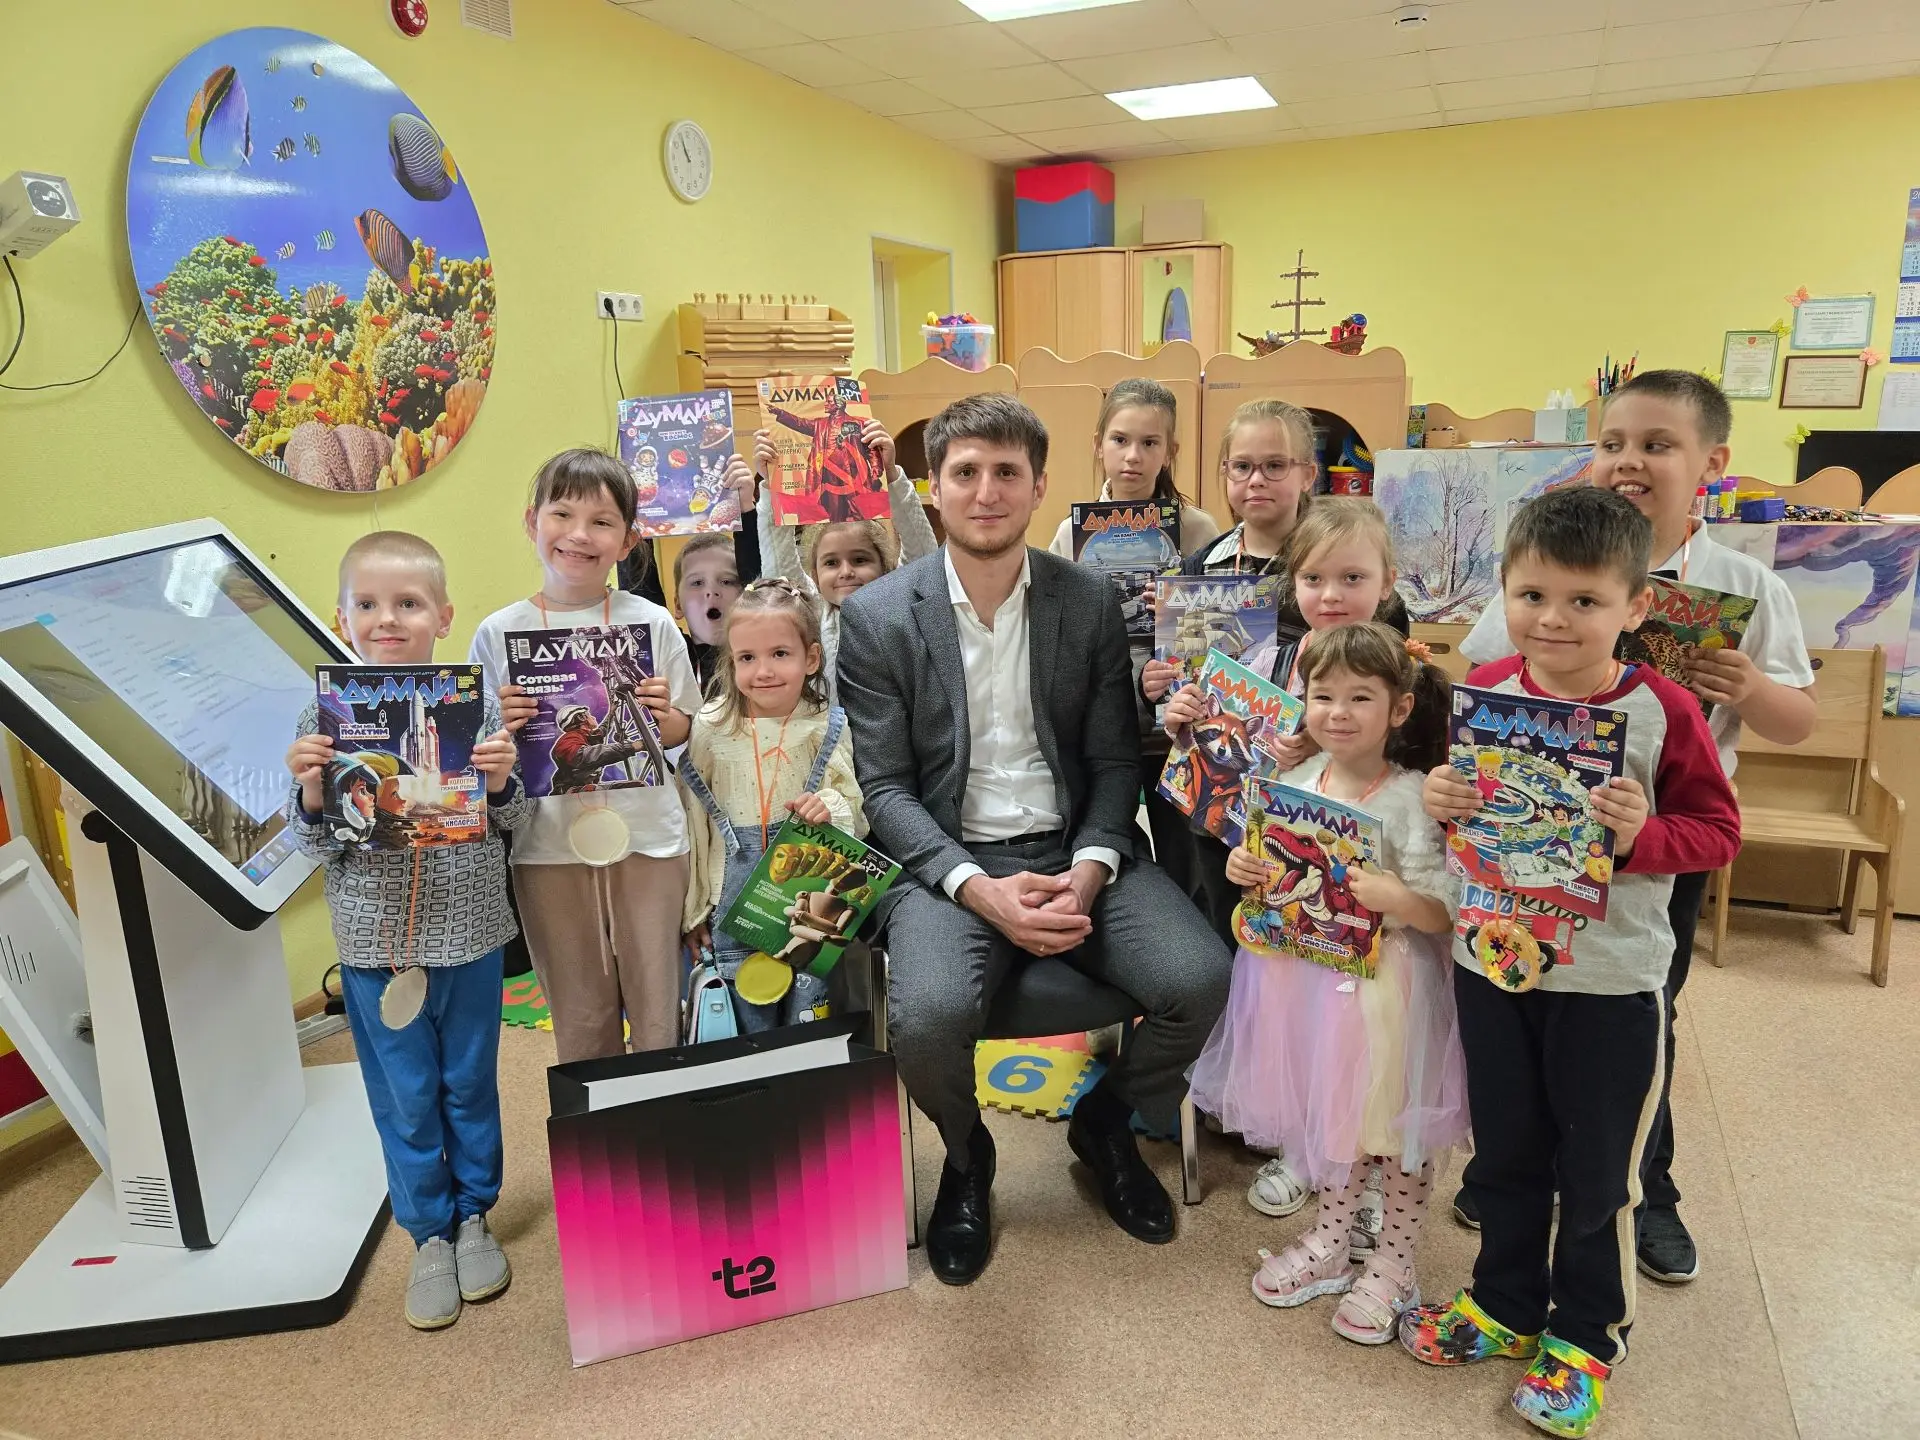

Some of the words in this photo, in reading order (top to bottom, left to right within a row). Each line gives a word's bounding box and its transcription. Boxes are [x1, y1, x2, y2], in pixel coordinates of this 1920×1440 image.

[1650, 588, 1722, 628] МАЙ
[337, 675, 458, 710] ДУМАЙ
[516, 673, 577, 685] Сотовая
[1467, 704, 1595, 750] ДУМАЙ
[1264, 795, 1359, 838] ДУМАЙ
[1468, 911, 1481, 925] The
[1300, 938, 1350, 956] ДИНОЗАВРЫ?
[988, 1055, 1053, 1094] 6
[711, 1255, 777, 1300] t2
